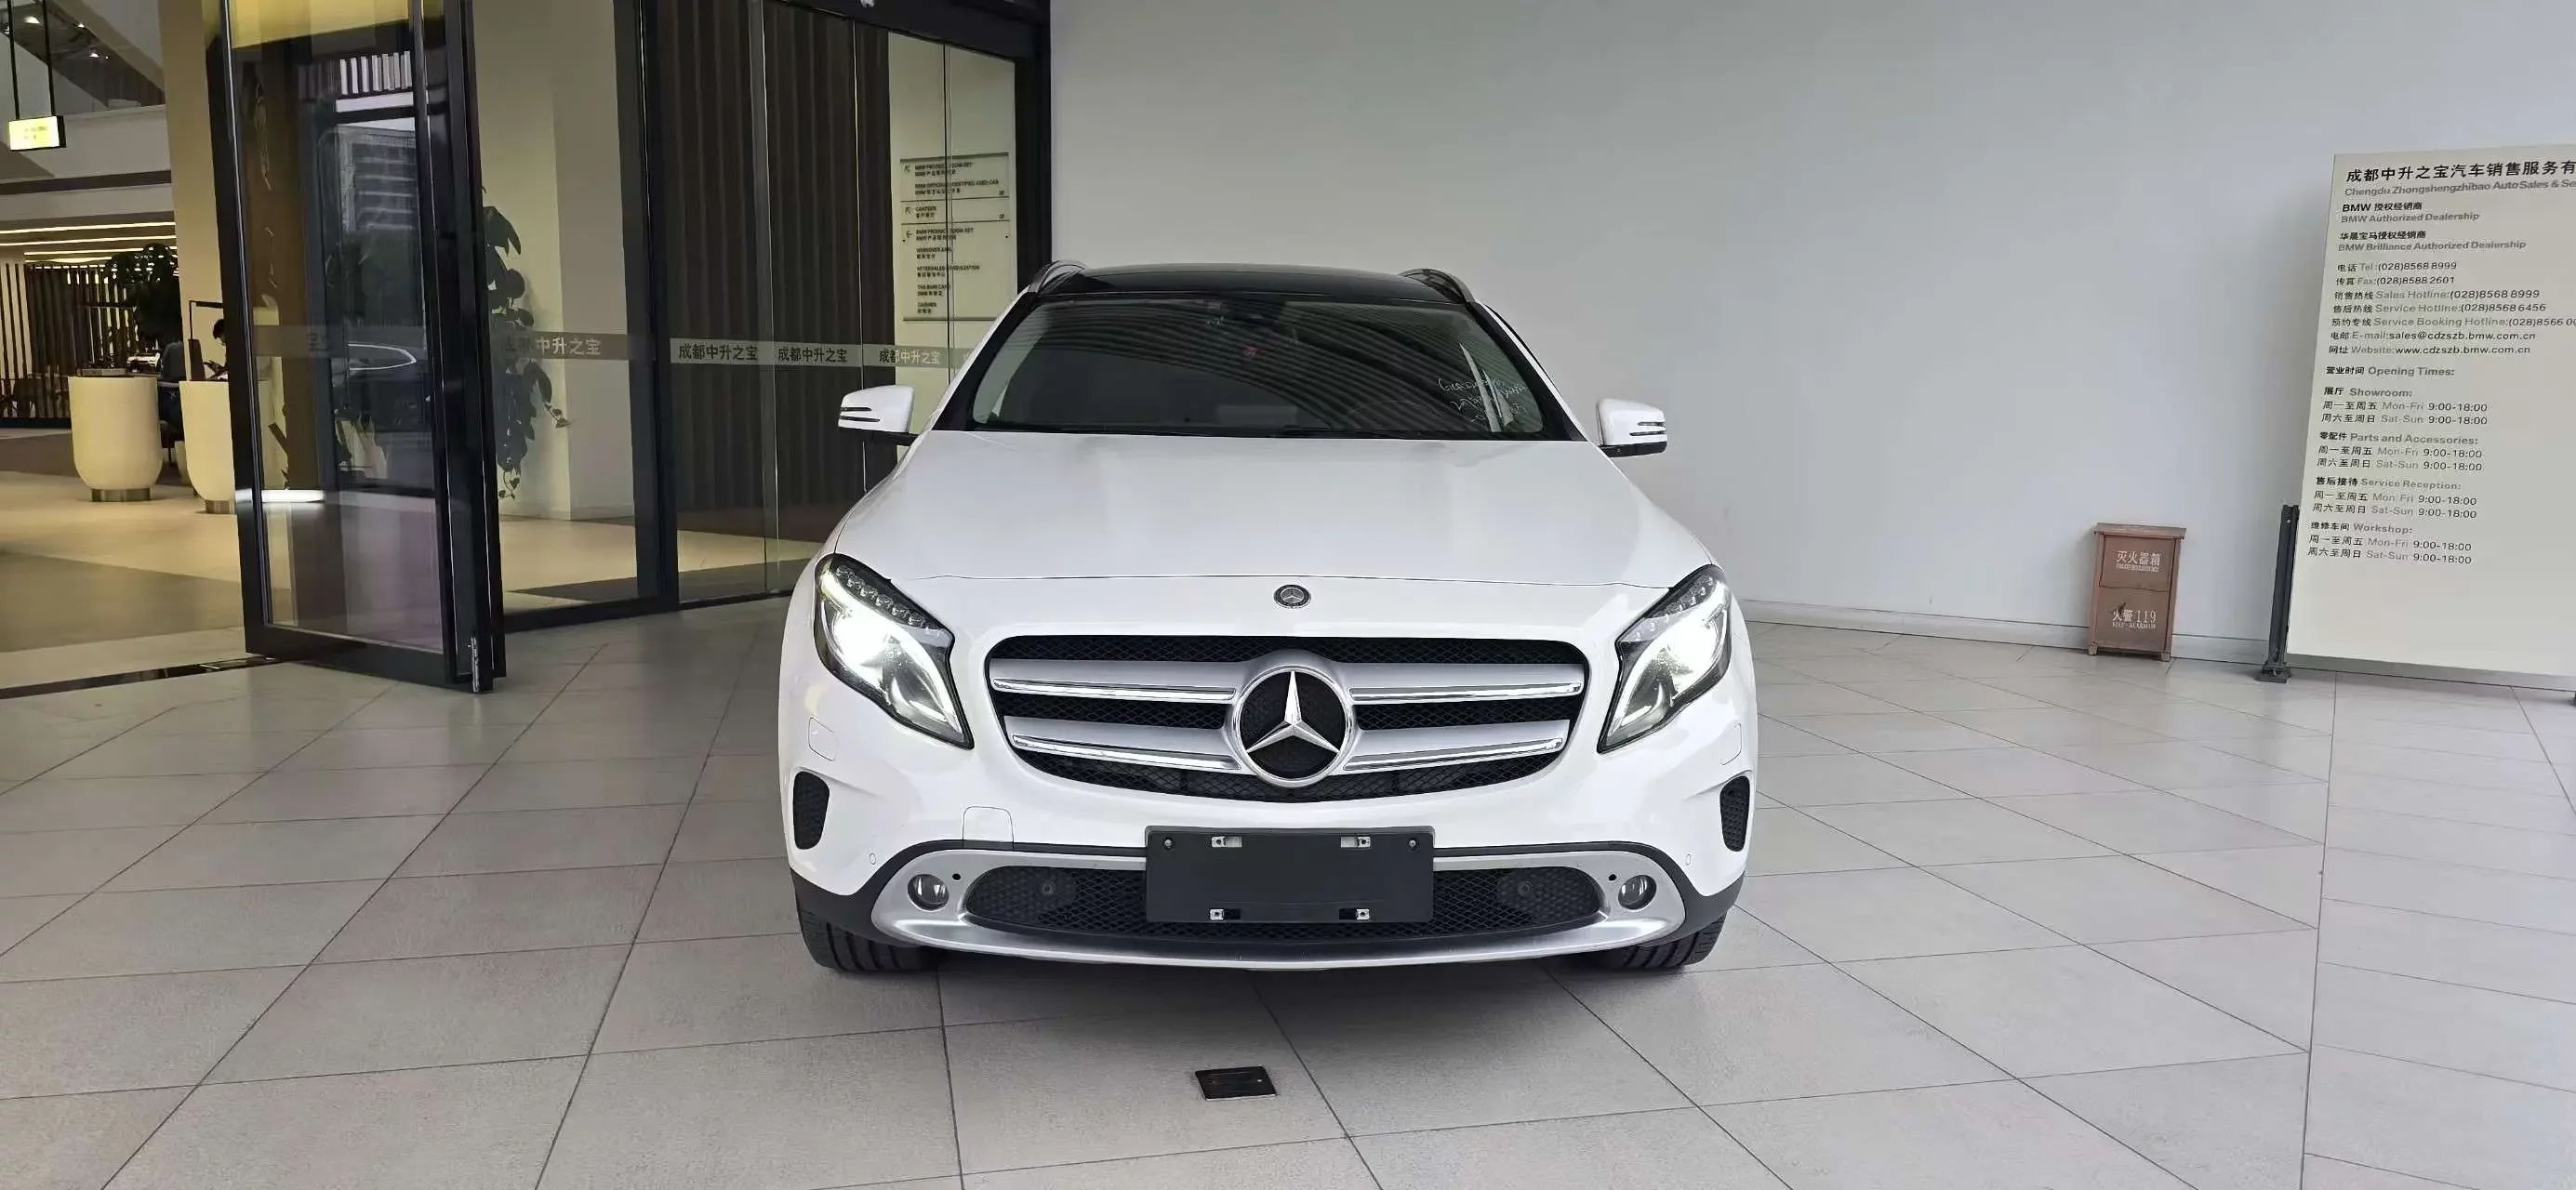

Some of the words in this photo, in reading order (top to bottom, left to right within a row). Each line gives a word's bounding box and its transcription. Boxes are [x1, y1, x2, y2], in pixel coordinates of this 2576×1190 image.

[2346, 160, 2576, 182] 成都中升之宝汽车销售服务有
[2344, 186, 2390, 196] Chengdu
[2392, 182, 2490, 194] Zhongshengzhibao
[2492, 181, 2518, 190] Auto
[2519, 180, 2549, 189] Sales
[2551, 179, 2559, 188] &
[2342, 204, 2371, 212] BMW
[2374, 202, 2423, 211] 授权经销商
[2341, 215, 2368, 223] BMW
[2368, 214, 2423, 222] Authorized
[2425, 212, 2480, 221] Dealership
[2340, 231, 2426, 240] 华晨宝马授权经销商
[2338, 243, 2364, 252] BMW
[2366, 242, 2412, 251] Brilliance
[2413, 241, 2469, 250] Authorized
[2471, 240, 2527, 250] Dealership
[2337, 264, 2357, 272] 电话
[2334, 291, 2373, 299] 销售热线
[2376, 290, 2405, 298] Sales
[2333, 305, 2372, 313] 售后热线
[2375, 304, 2415, 312] Service
[2331, 318, 2372, 326] 预约专线
[2373, 317, 2414, 326] Service
[2417, 316, 2463, 327] Booking
[679, 342, 759, 361] 成都中升之宝
[778, 347, 848, 364] 成都中升之宝
[879, 349, 941, 364] 成都中升之宝
[2329, 346, 2348, 354] 网址
[2326, 365, 2365, 375] 营业时间
[2368, 366, 2415, 377] Opening
[2417, 366, 2455, 377] Times:
[2324, 387, 2344, 396] 展厅
[2349, 388, 2412, 398] Showroom:
[2322, 401, 2377, 411] 周一至周五
[2382, 402, 2423, 411] Mon-Fri
[2428, 403, 2488, 412] 9:00-18:00
[2321, 413, 2375, 424] 周六至周日
[2381, 415, 2423, 424] Sat-Sun
[2428, 416, 2488, 426] 9:00-18:00
[2319, 431, 2347, 441] 零配件
[2350, 432, 2379, 442] Parts
[2382, 434, 2402, 443] and
[2404, 435, 2477, 445] Accessories:
[2318, 445, 2372, 456] 周一至周五
[2377, 447, 2418, 456] Mon-Fri
[2423, 448, 2482, 458] 9:00-18:00
[2317, 457, 2370, 468] 周六至周日
[2376, 459, 2419, 469] Sat-Sun
[2423, 461, 2482, 471] 9:00-18:00
[2316, 476, 2358, 486] 售后接待
[2361, 478, 2400, 488] Service
[2403, 480, 2462, 490] Reception:
[2314, 490, 2368, 501] 周一至周五
[2418, 496, 2476, 506] 9:00-18:00
[2313, 503, 2366, 513] 周六至周日
[2370, 505, 2413, 515] Sat-Sun
[2418, 509, 2476, 519] 9:00-18:00
[2311, 521, 2350, 532] 维修车间
[2354, 522, 2413, 535] Workshop:
[2309, 535, 2363, 546] 周一至周五
[2368, 537, 2409, 548] Mon-Fri
[2413, 540, 2472, 551] 9:00-18:00
[2116, 550, 2160, 566] 灭火器箱
[2307, 547, 2361, 558] 周六至周日
[2366, 550, 2409, 561] Sat-Sun
[2413, 553, 2472, 563] 9:00-18:00
